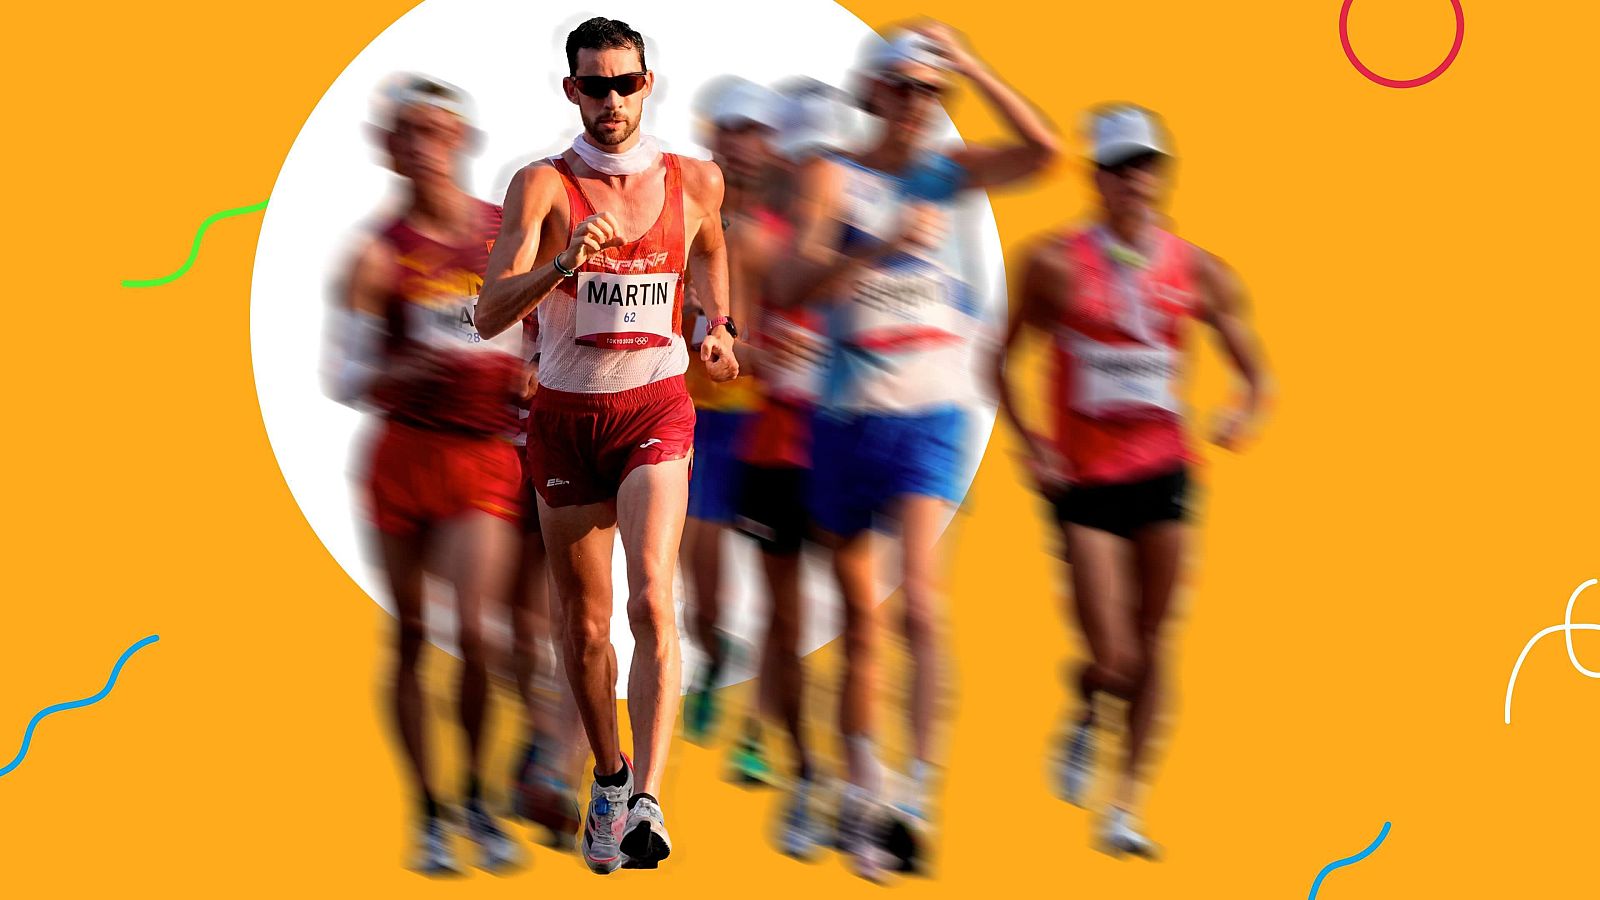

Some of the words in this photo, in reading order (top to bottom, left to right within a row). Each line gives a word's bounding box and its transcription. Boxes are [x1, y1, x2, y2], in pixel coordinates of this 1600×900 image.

[587, 281, 669, 307] MARTIN
[623, 312, 636, 323] 62
[466, 332, 481, 344] 28
